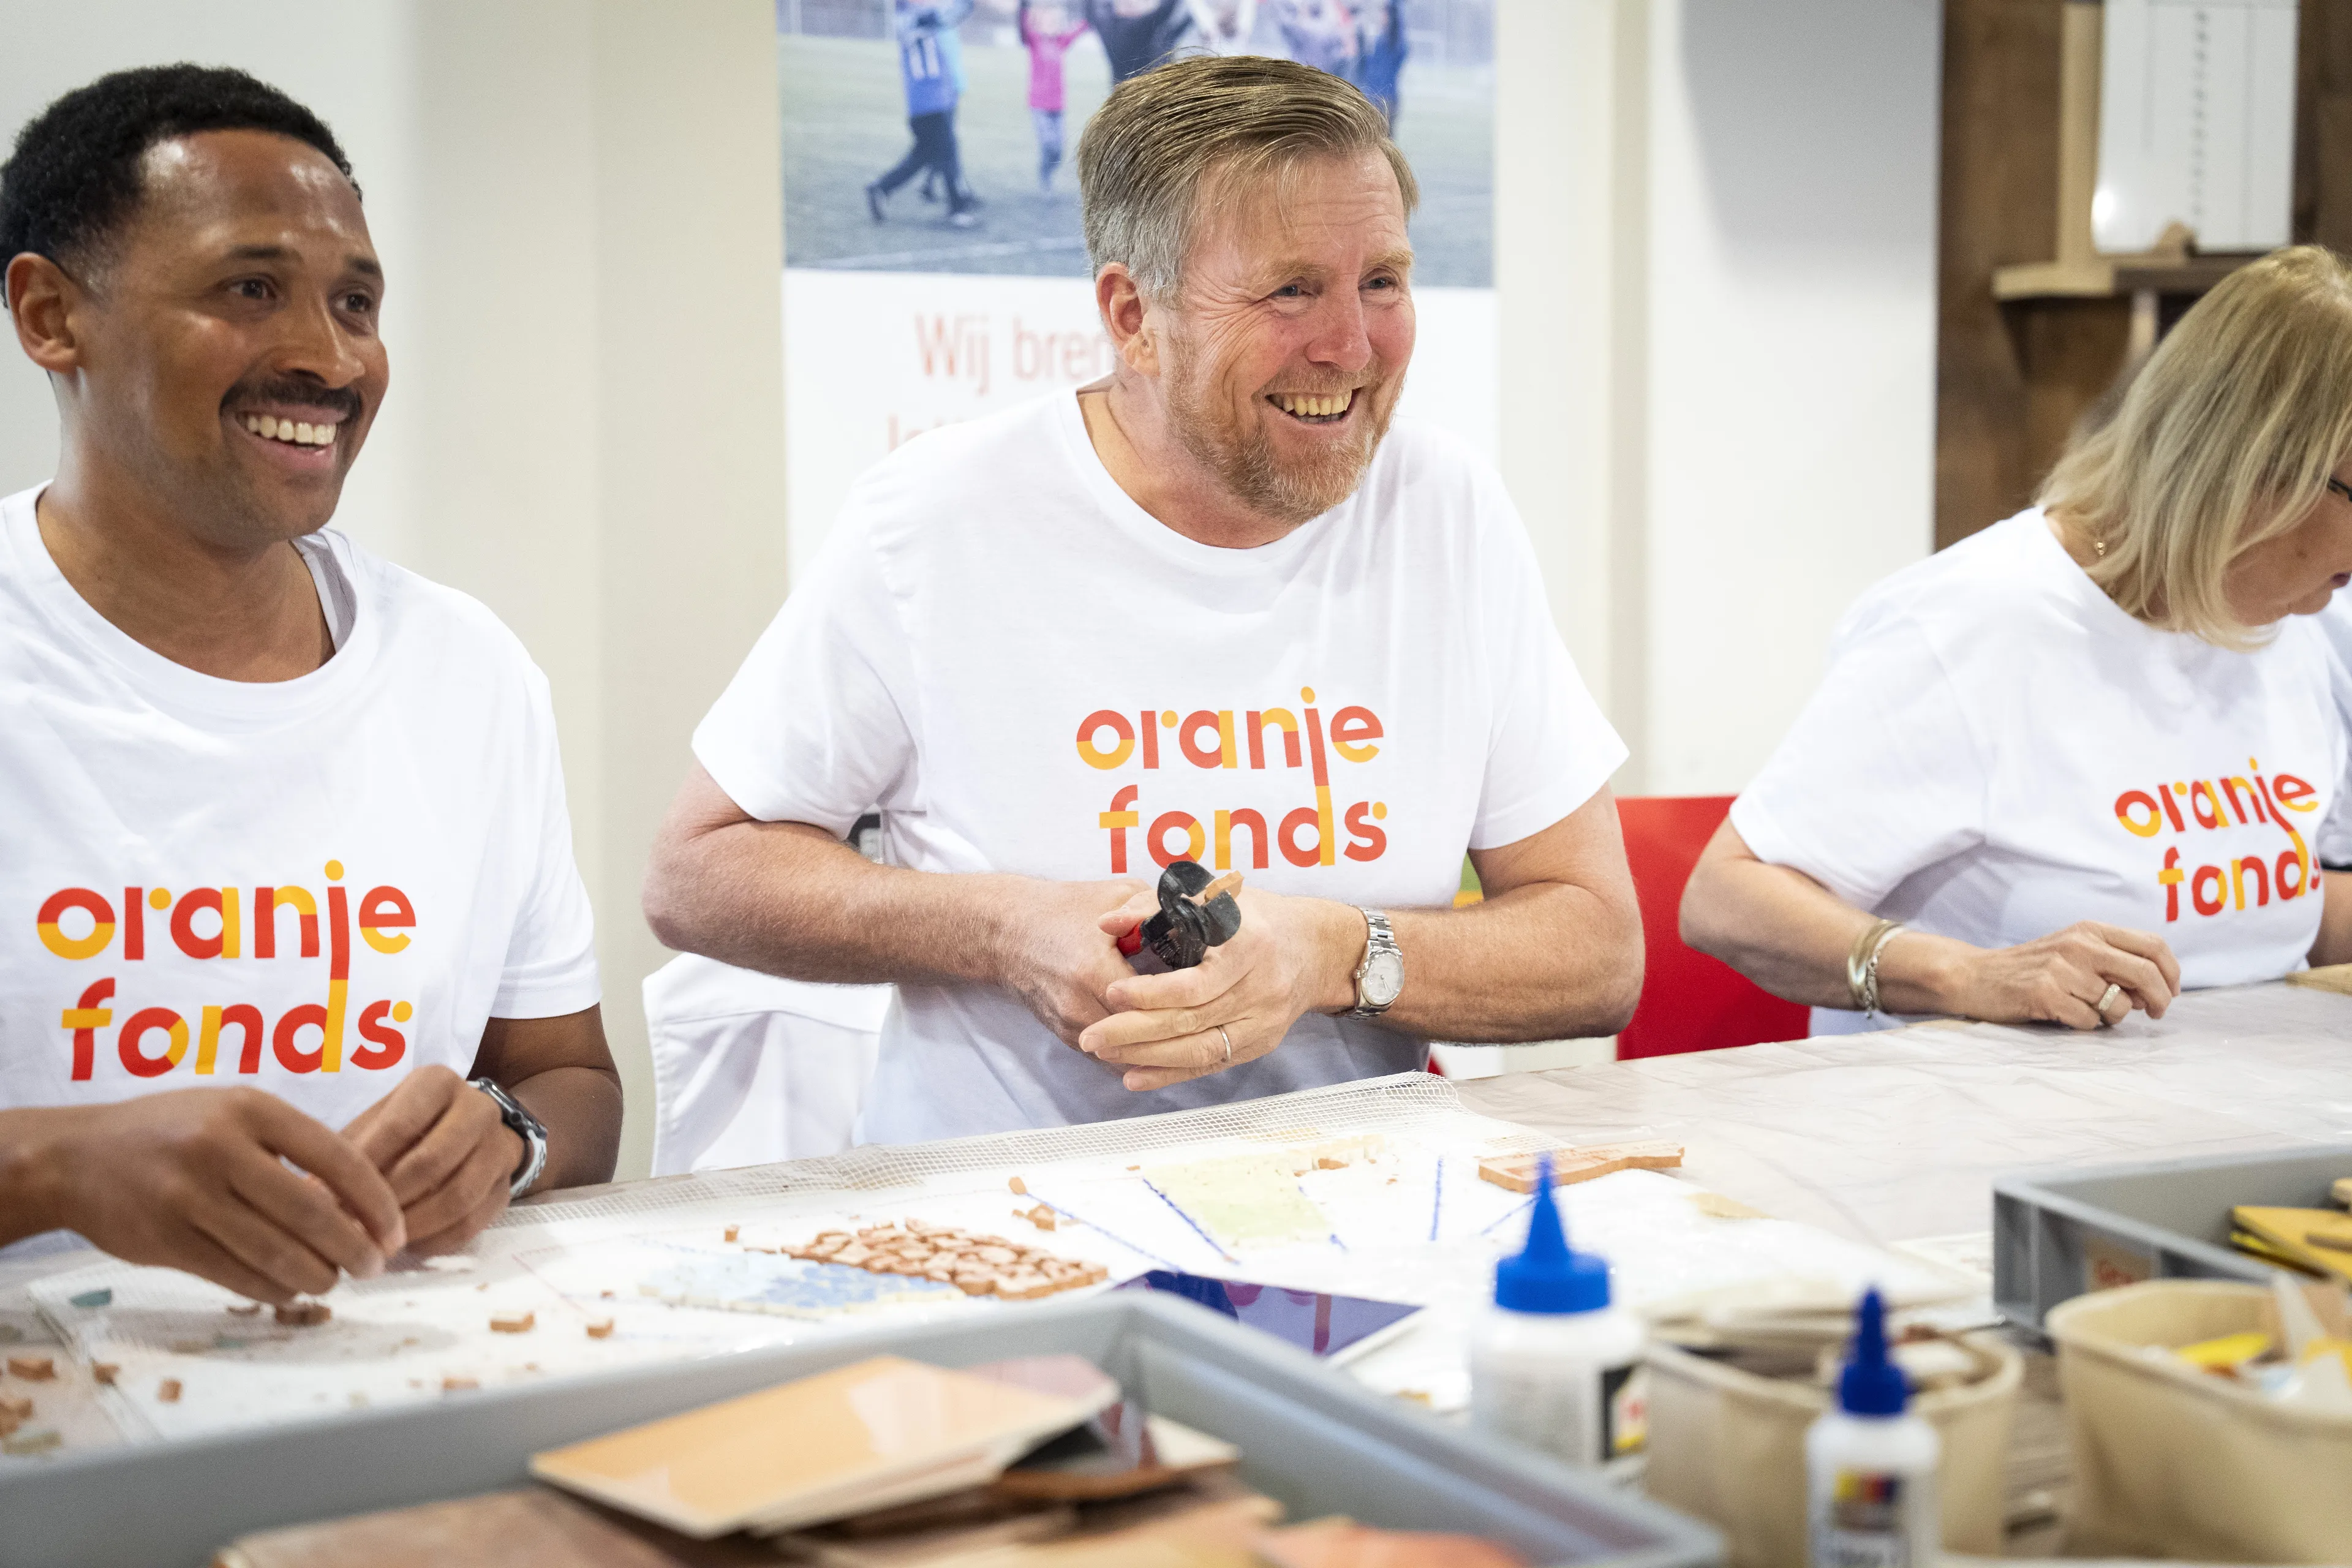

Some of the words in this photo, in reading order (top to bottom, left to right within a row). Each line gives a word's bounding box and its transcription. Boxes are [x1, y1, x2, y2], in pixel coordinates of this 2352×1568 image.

[915, 314, 990, 396] Wij
[1076, 686, 1384, 786] oranje
[1099, 785, 1387, 873] fonds
[2114, 756, 2320, 838] oranje
[37, 859, 417, 980] oranje
[62, 977, 412, 1081] fonds
